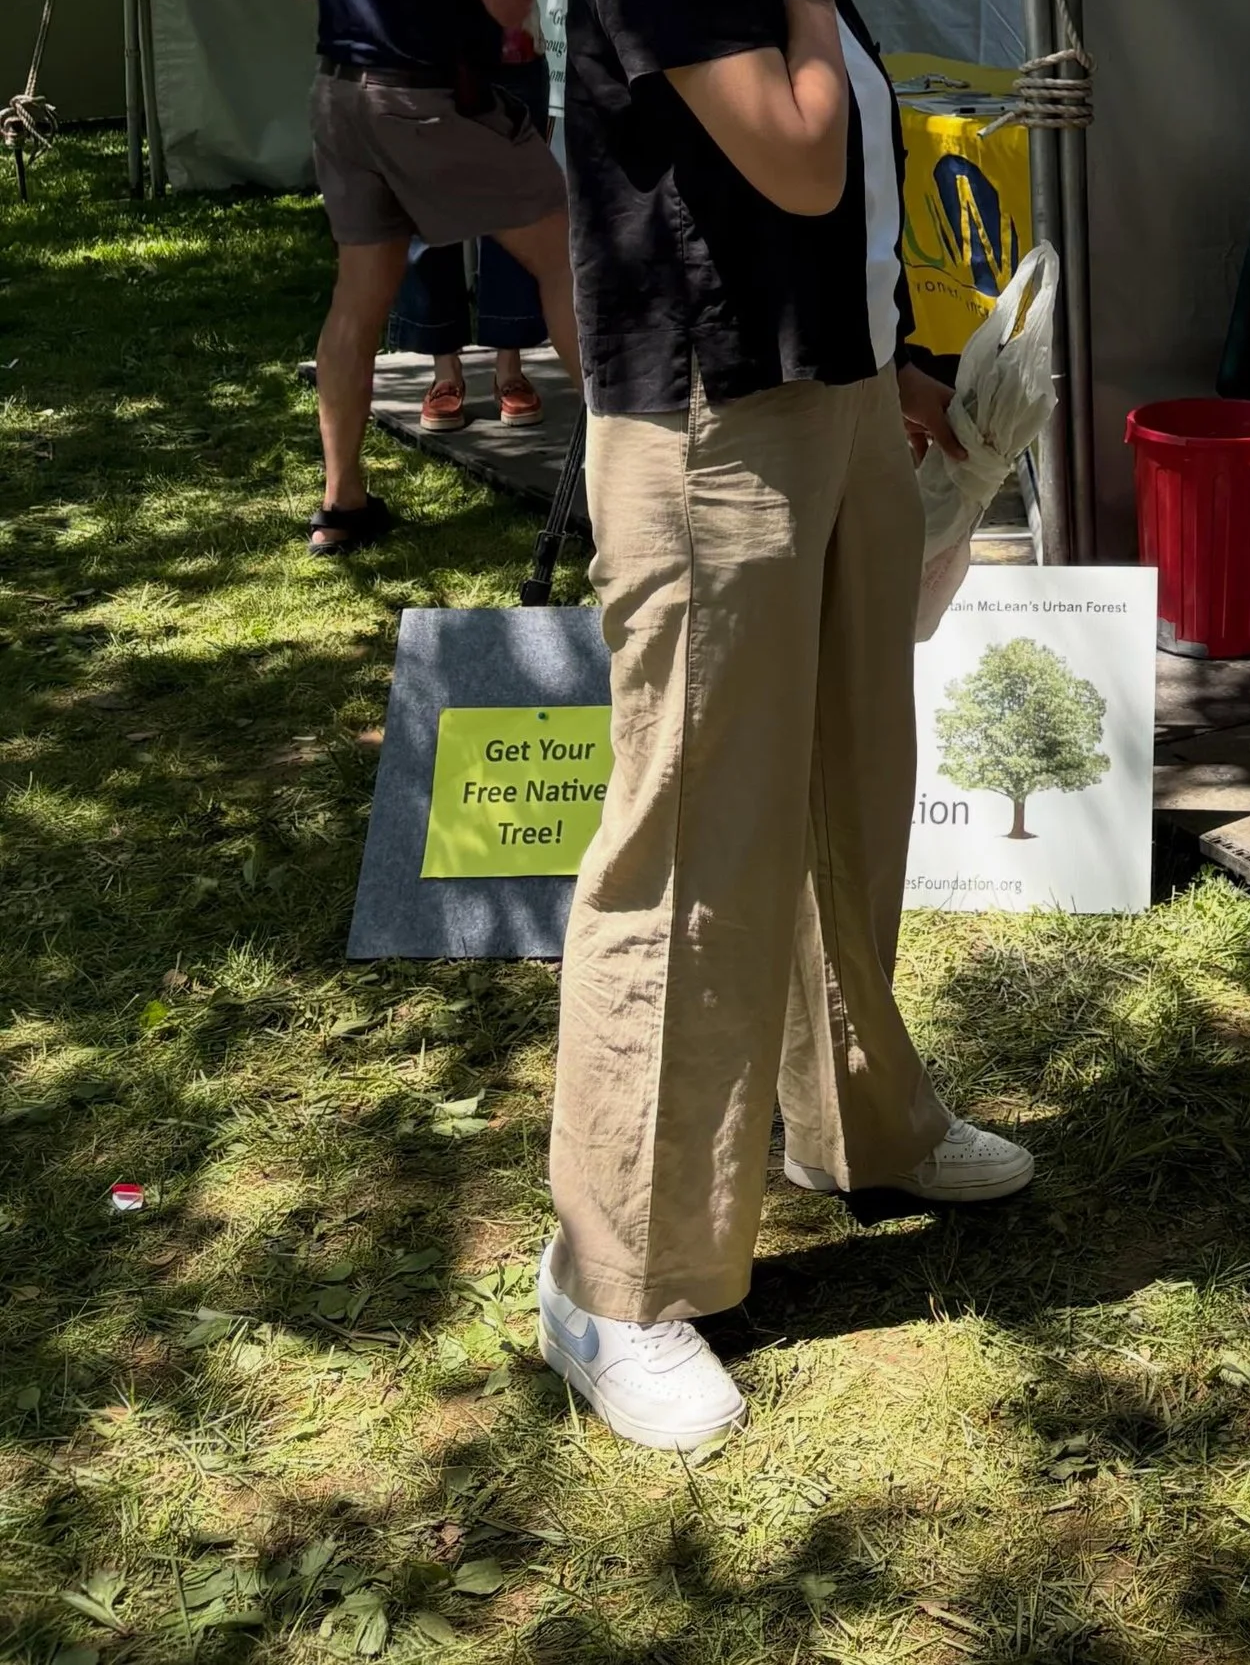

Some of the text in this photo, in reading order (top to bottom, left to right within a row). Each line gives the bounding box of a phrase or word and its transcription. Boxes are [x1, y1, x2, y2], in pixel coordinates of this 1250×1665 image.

[977, 600, 1039, 613] McLean's
[1042, 600, 1082, 613] Urban
[1086, 601, 1128, 613] Forest
[485, 739, 595, 763] Get Your
[463, 778, 607, 804] Free Native
[498, 820, 563, 845] Tree!
